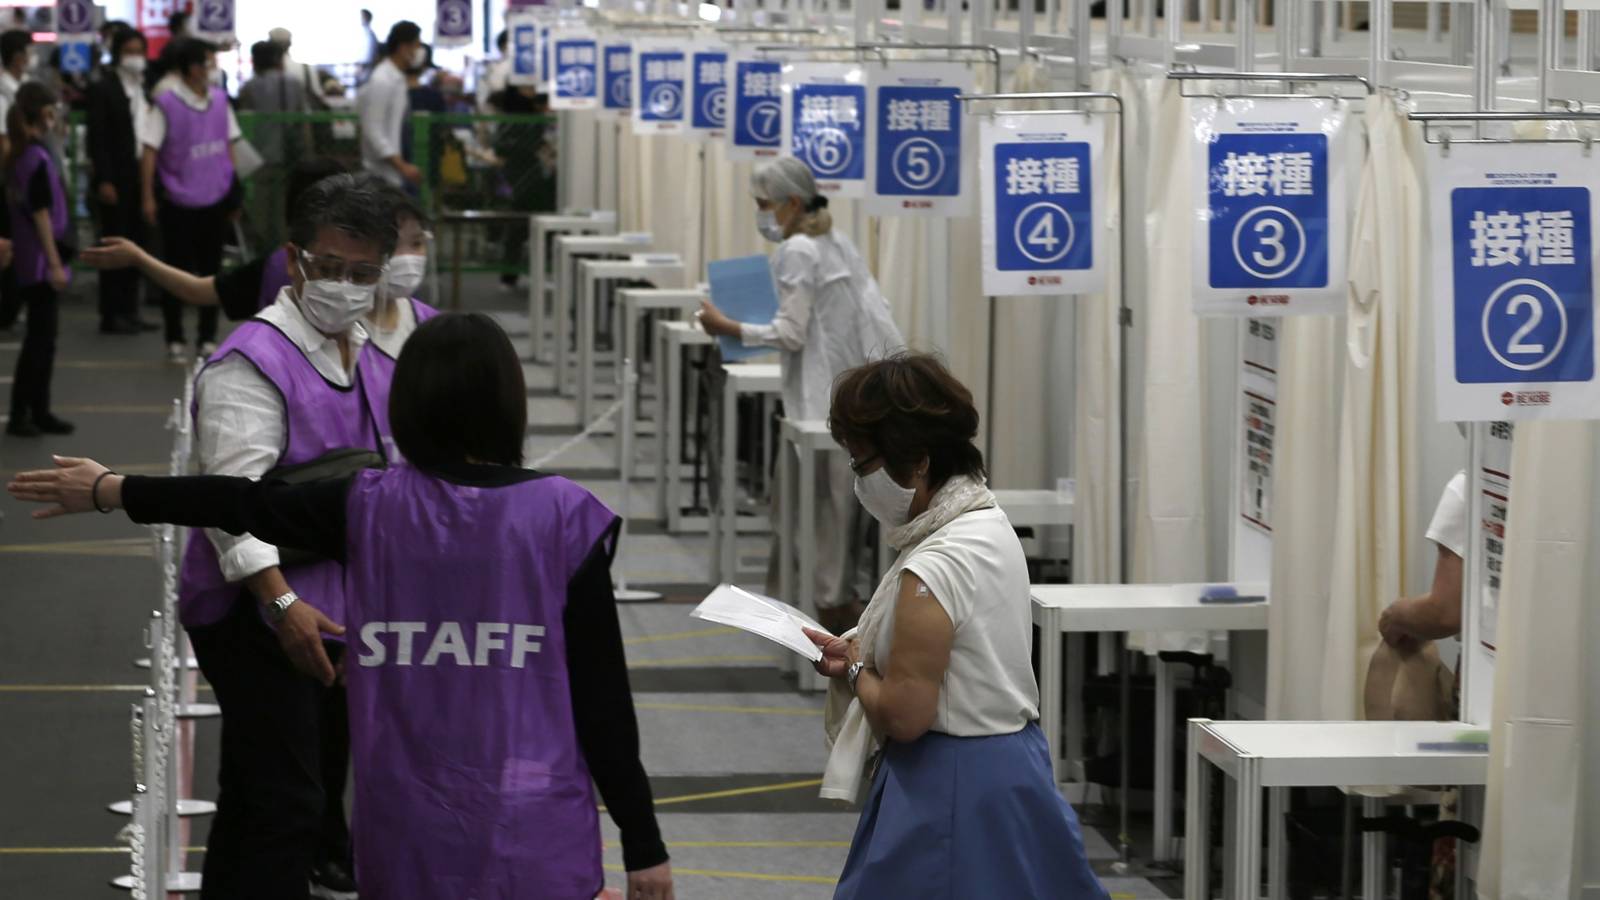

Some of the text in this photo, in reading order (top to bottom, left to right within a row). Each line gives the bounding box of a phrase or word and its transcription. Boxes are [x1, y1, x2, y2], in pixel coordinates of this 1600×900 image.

[886, 99, 951, 131] 接種
[1005, 157, 1080, 195] 接種
[1222, 152, 1314, 196] 接種
[1469, 211, 1575, 266] 接種
[358, 621, 546, 668] STAFF
